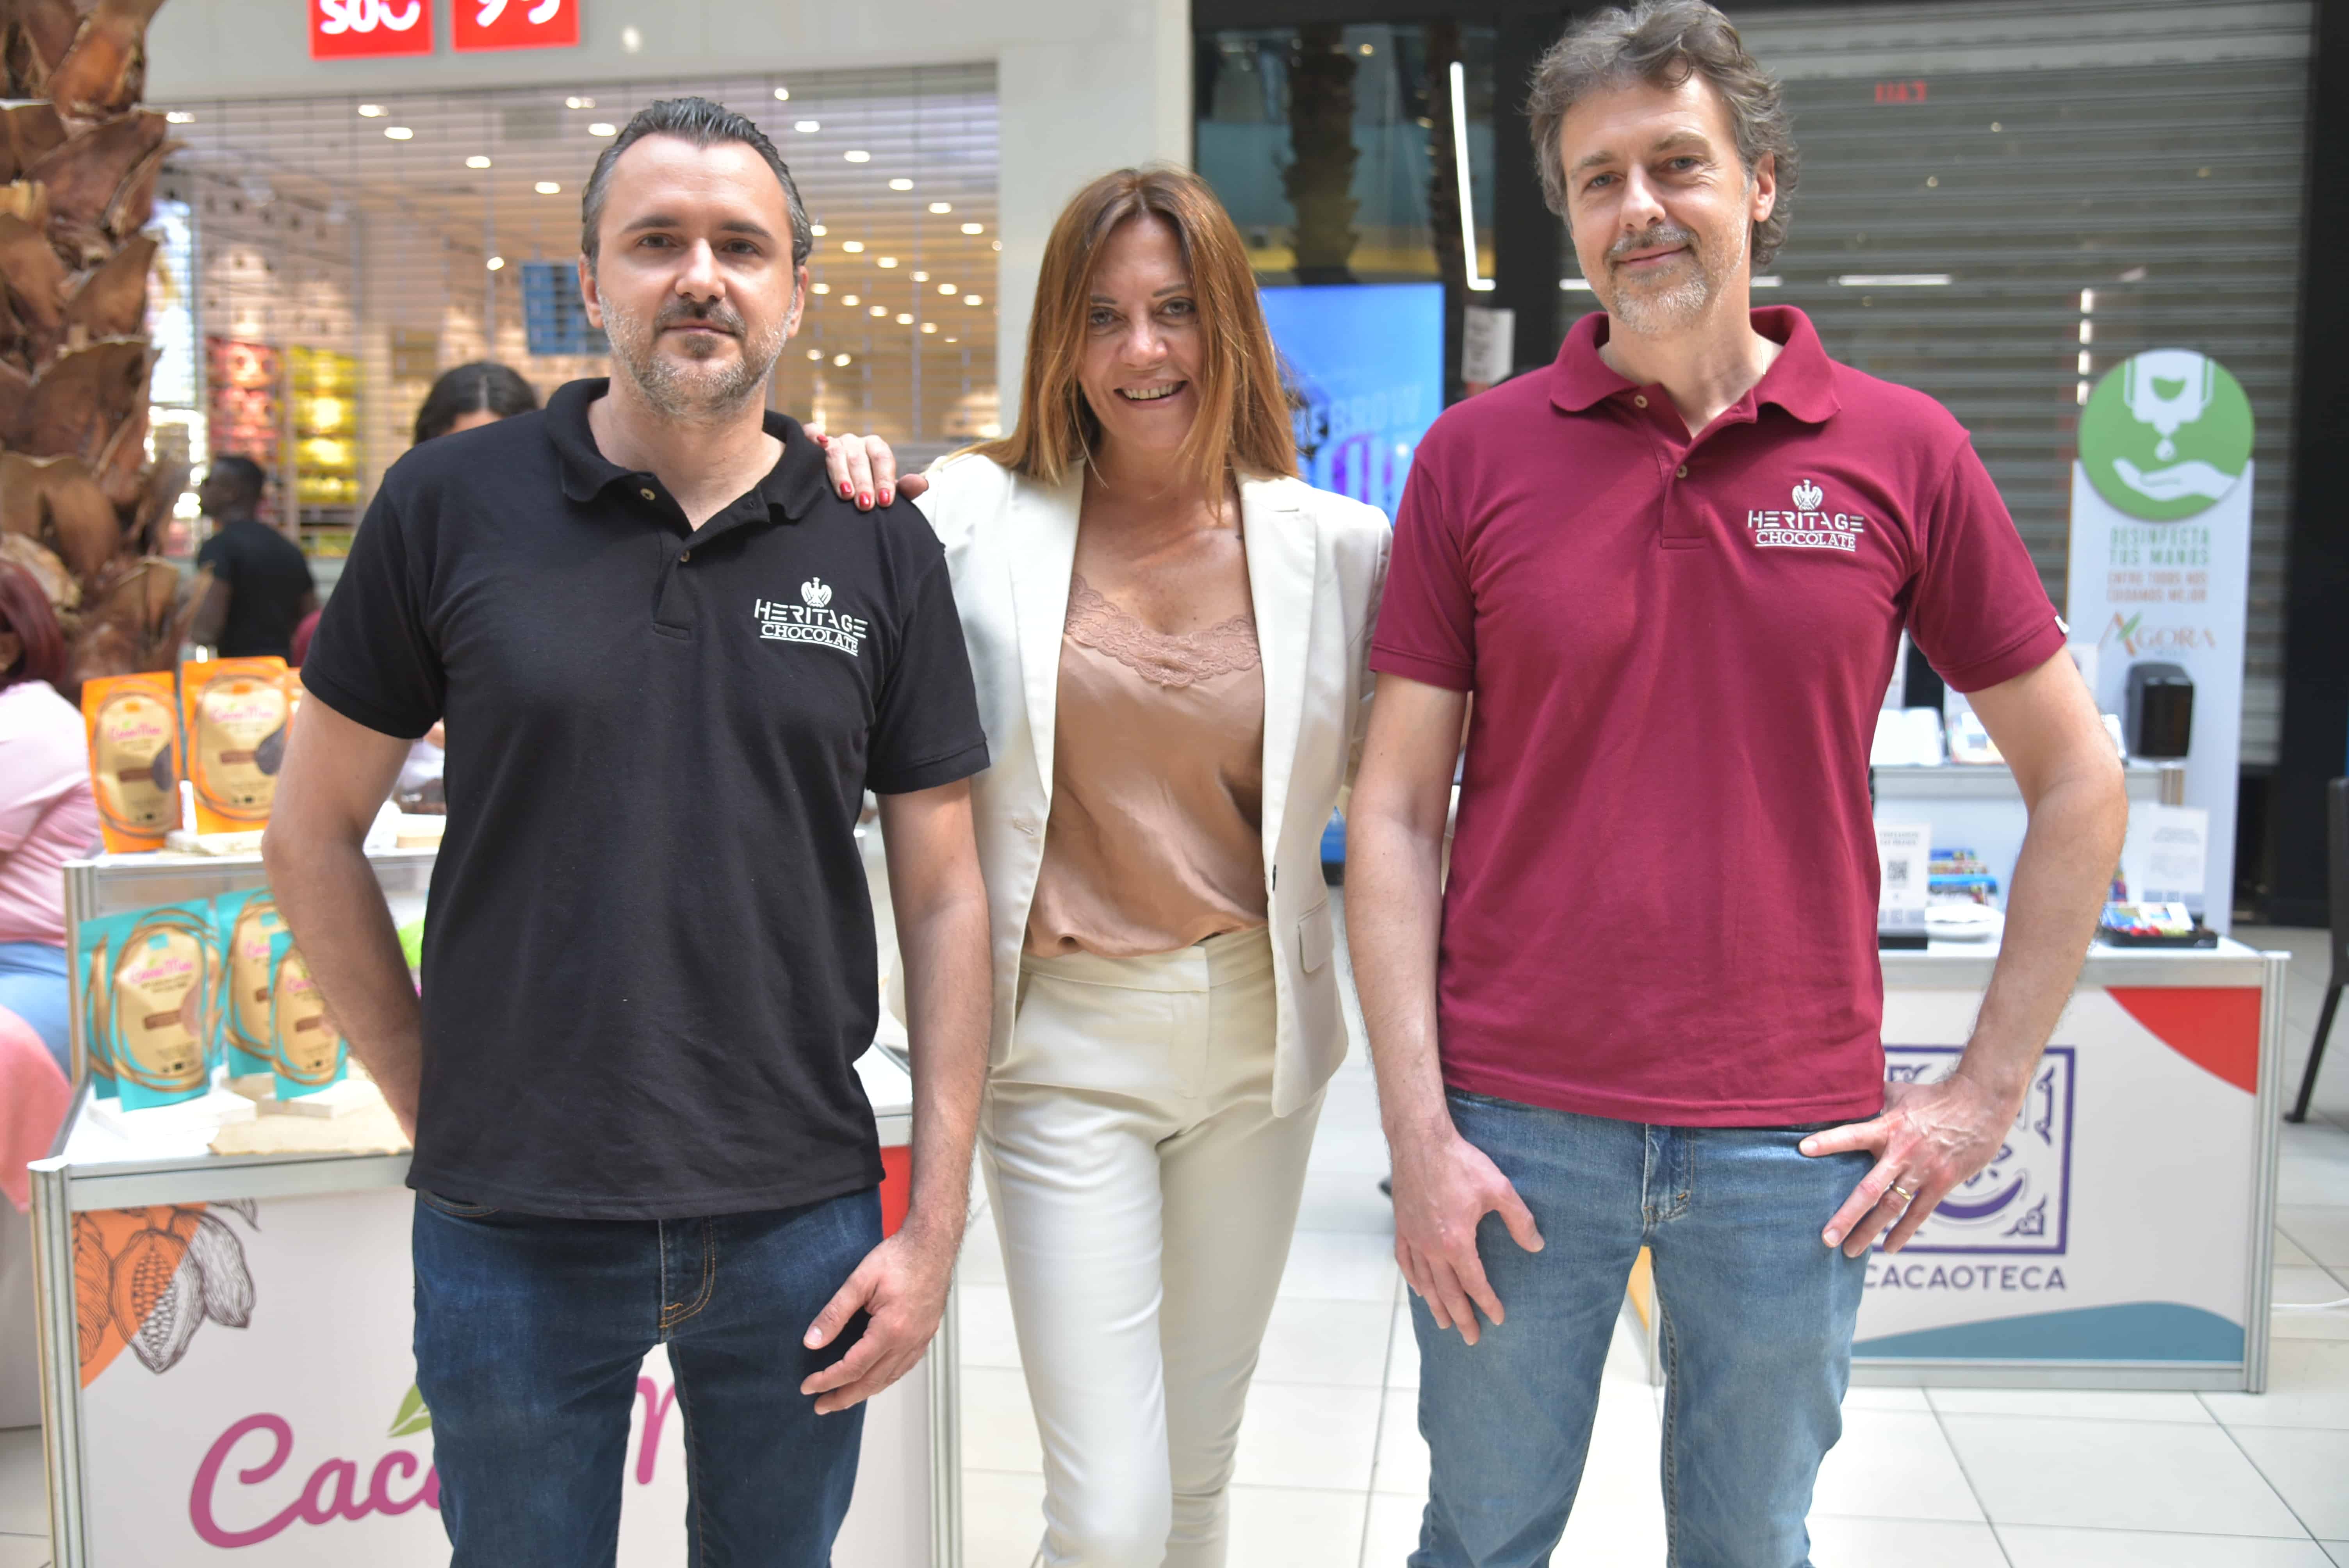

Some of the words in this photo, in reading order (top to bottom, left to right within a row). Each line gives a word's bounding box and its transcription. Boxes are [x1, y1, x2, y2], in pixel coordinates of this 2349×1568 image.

[1747, 509, 1864, 533] HERITAGE
[1756, 532, 1856, 549] CHOCOLATE
[2110, 527, 2210, 545] DESINFECTA
[2110, 549, 2140, 565] TUS
[2150, 549, 2209, 565] MANOS
[754, 598, 868, 639] HERITAGE
[761, 624, 859, 653] CHOCOLATE
